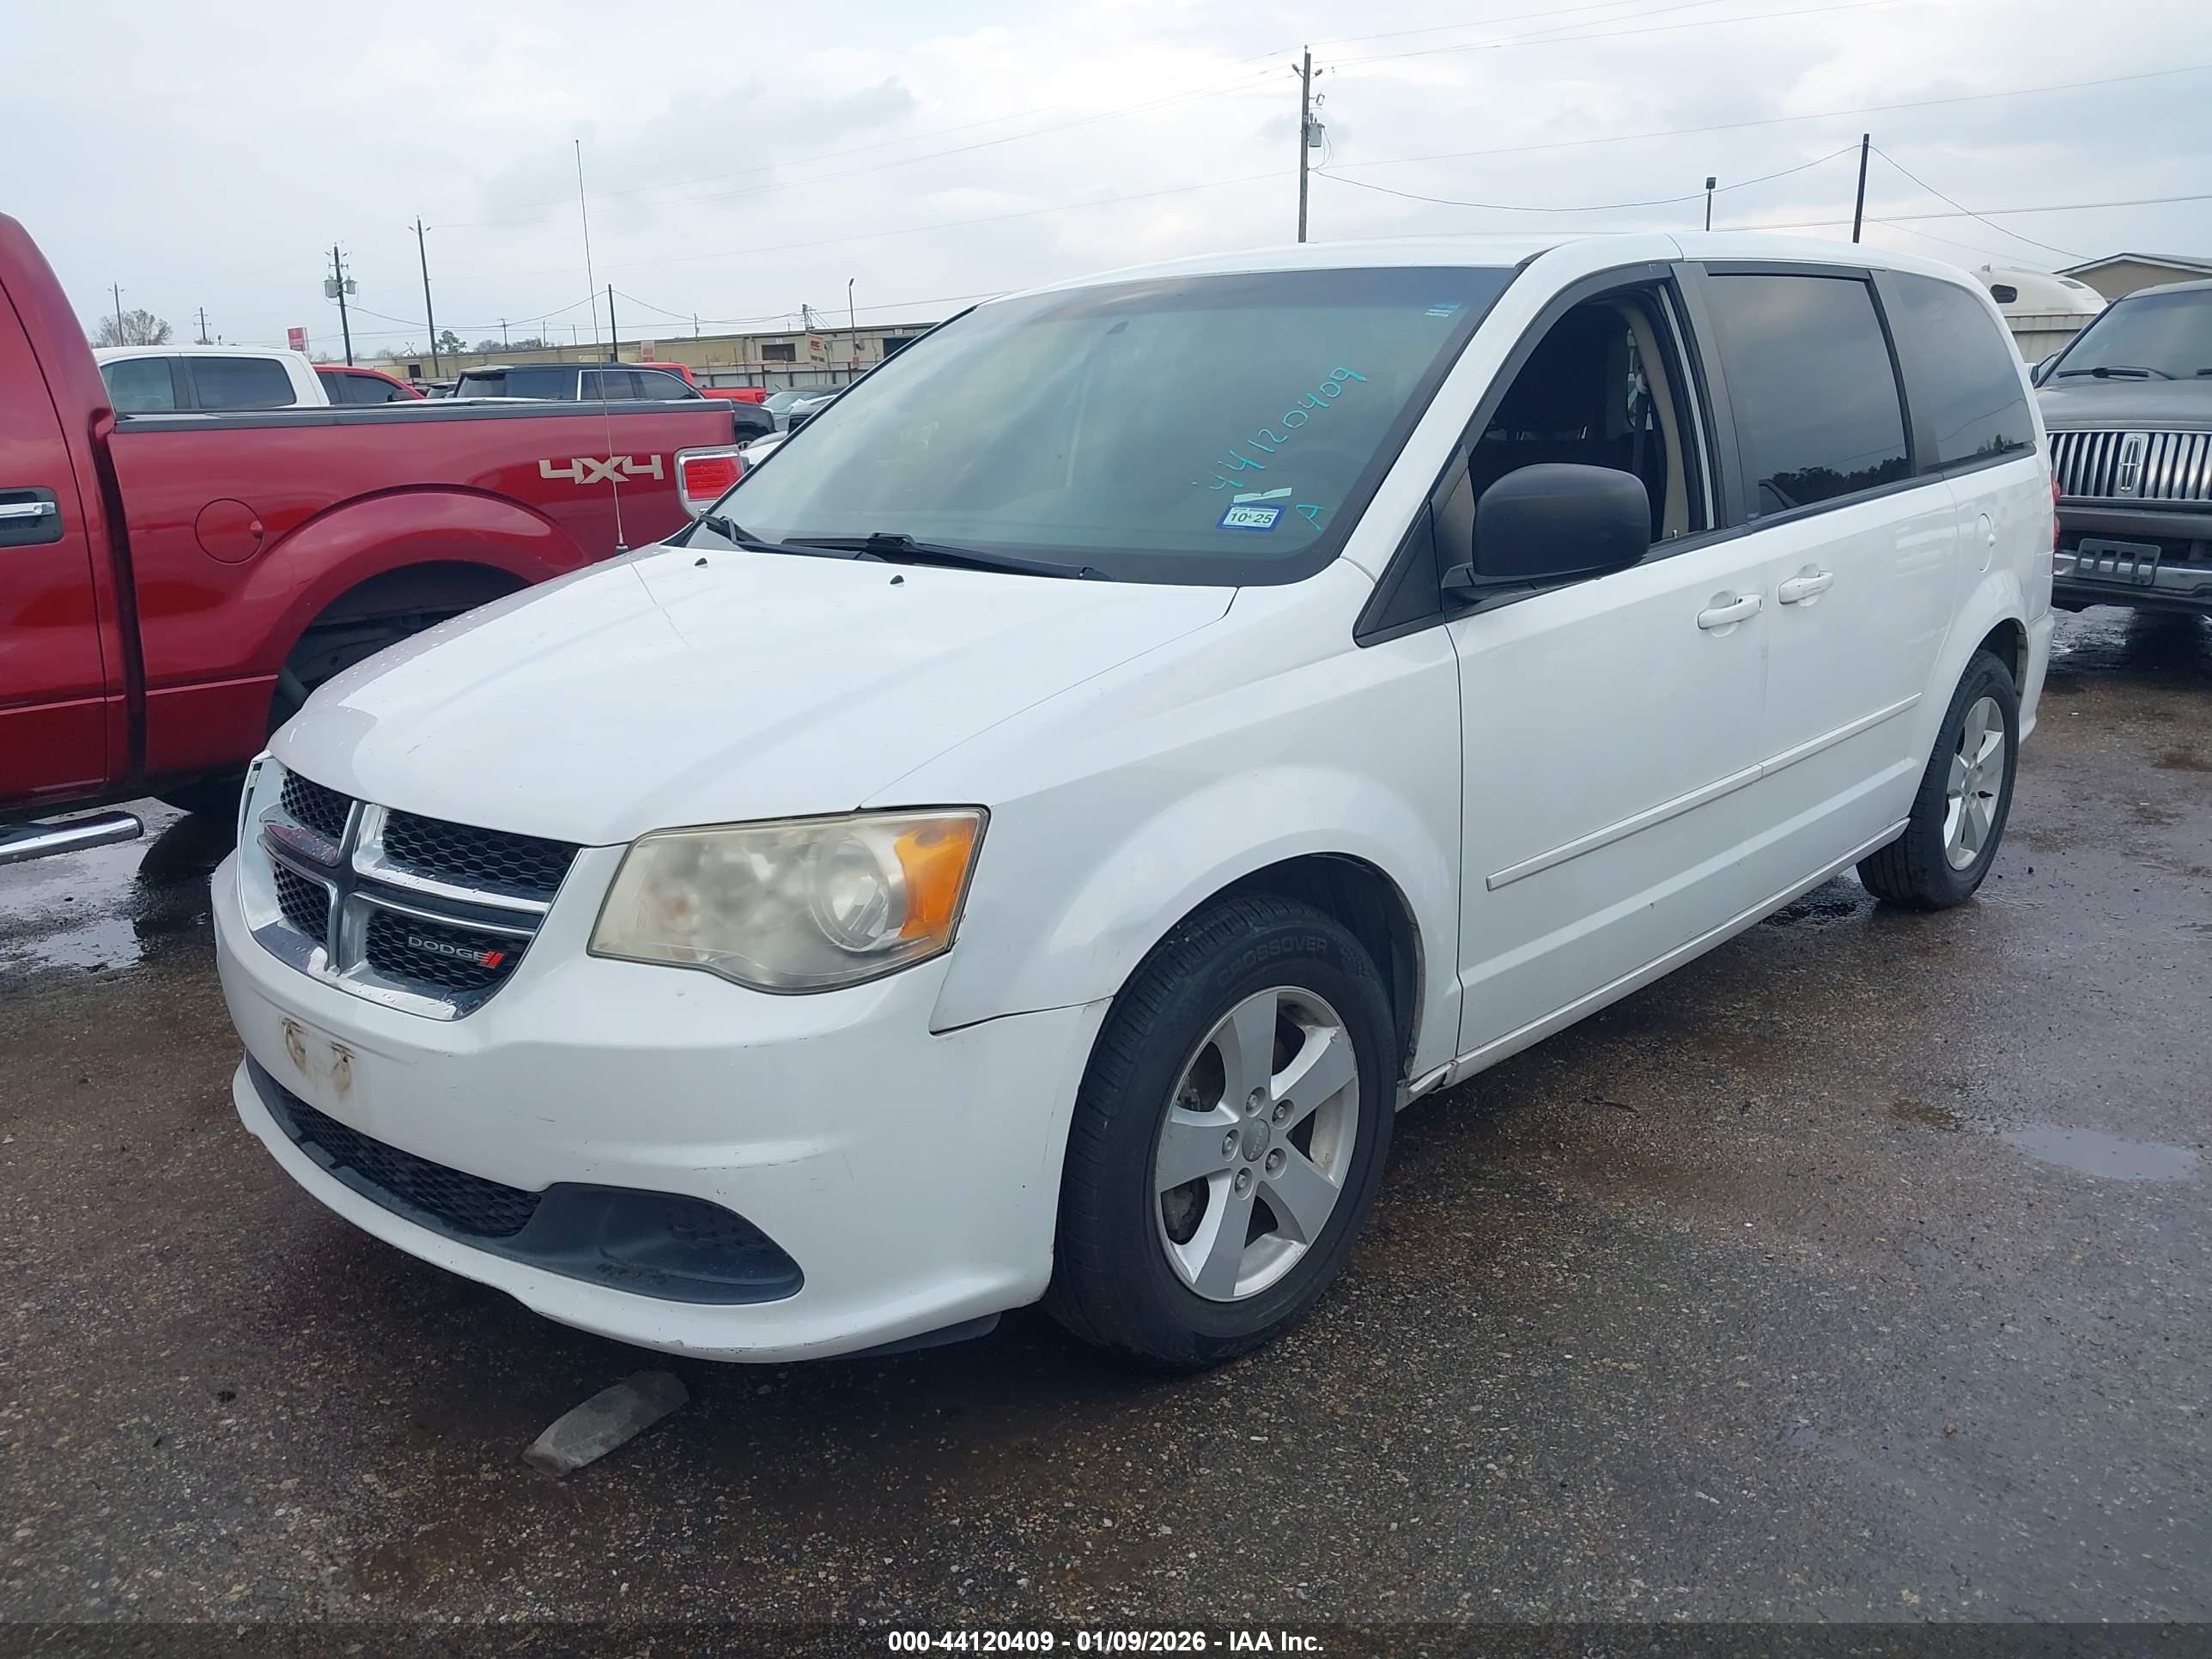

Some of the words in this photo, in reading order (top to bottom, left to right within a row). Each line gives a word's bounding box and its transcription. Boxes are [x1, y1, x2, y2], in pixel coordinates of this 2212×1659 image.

[1209, 367, 1369, 489] 44120409
[1231, 512, 1248, 523] 10
[1253, 513, 1274, 524] 25
[408, 936, 490, 962] DODGE
[1216, 935, 1328, 988] CROSSOVER
